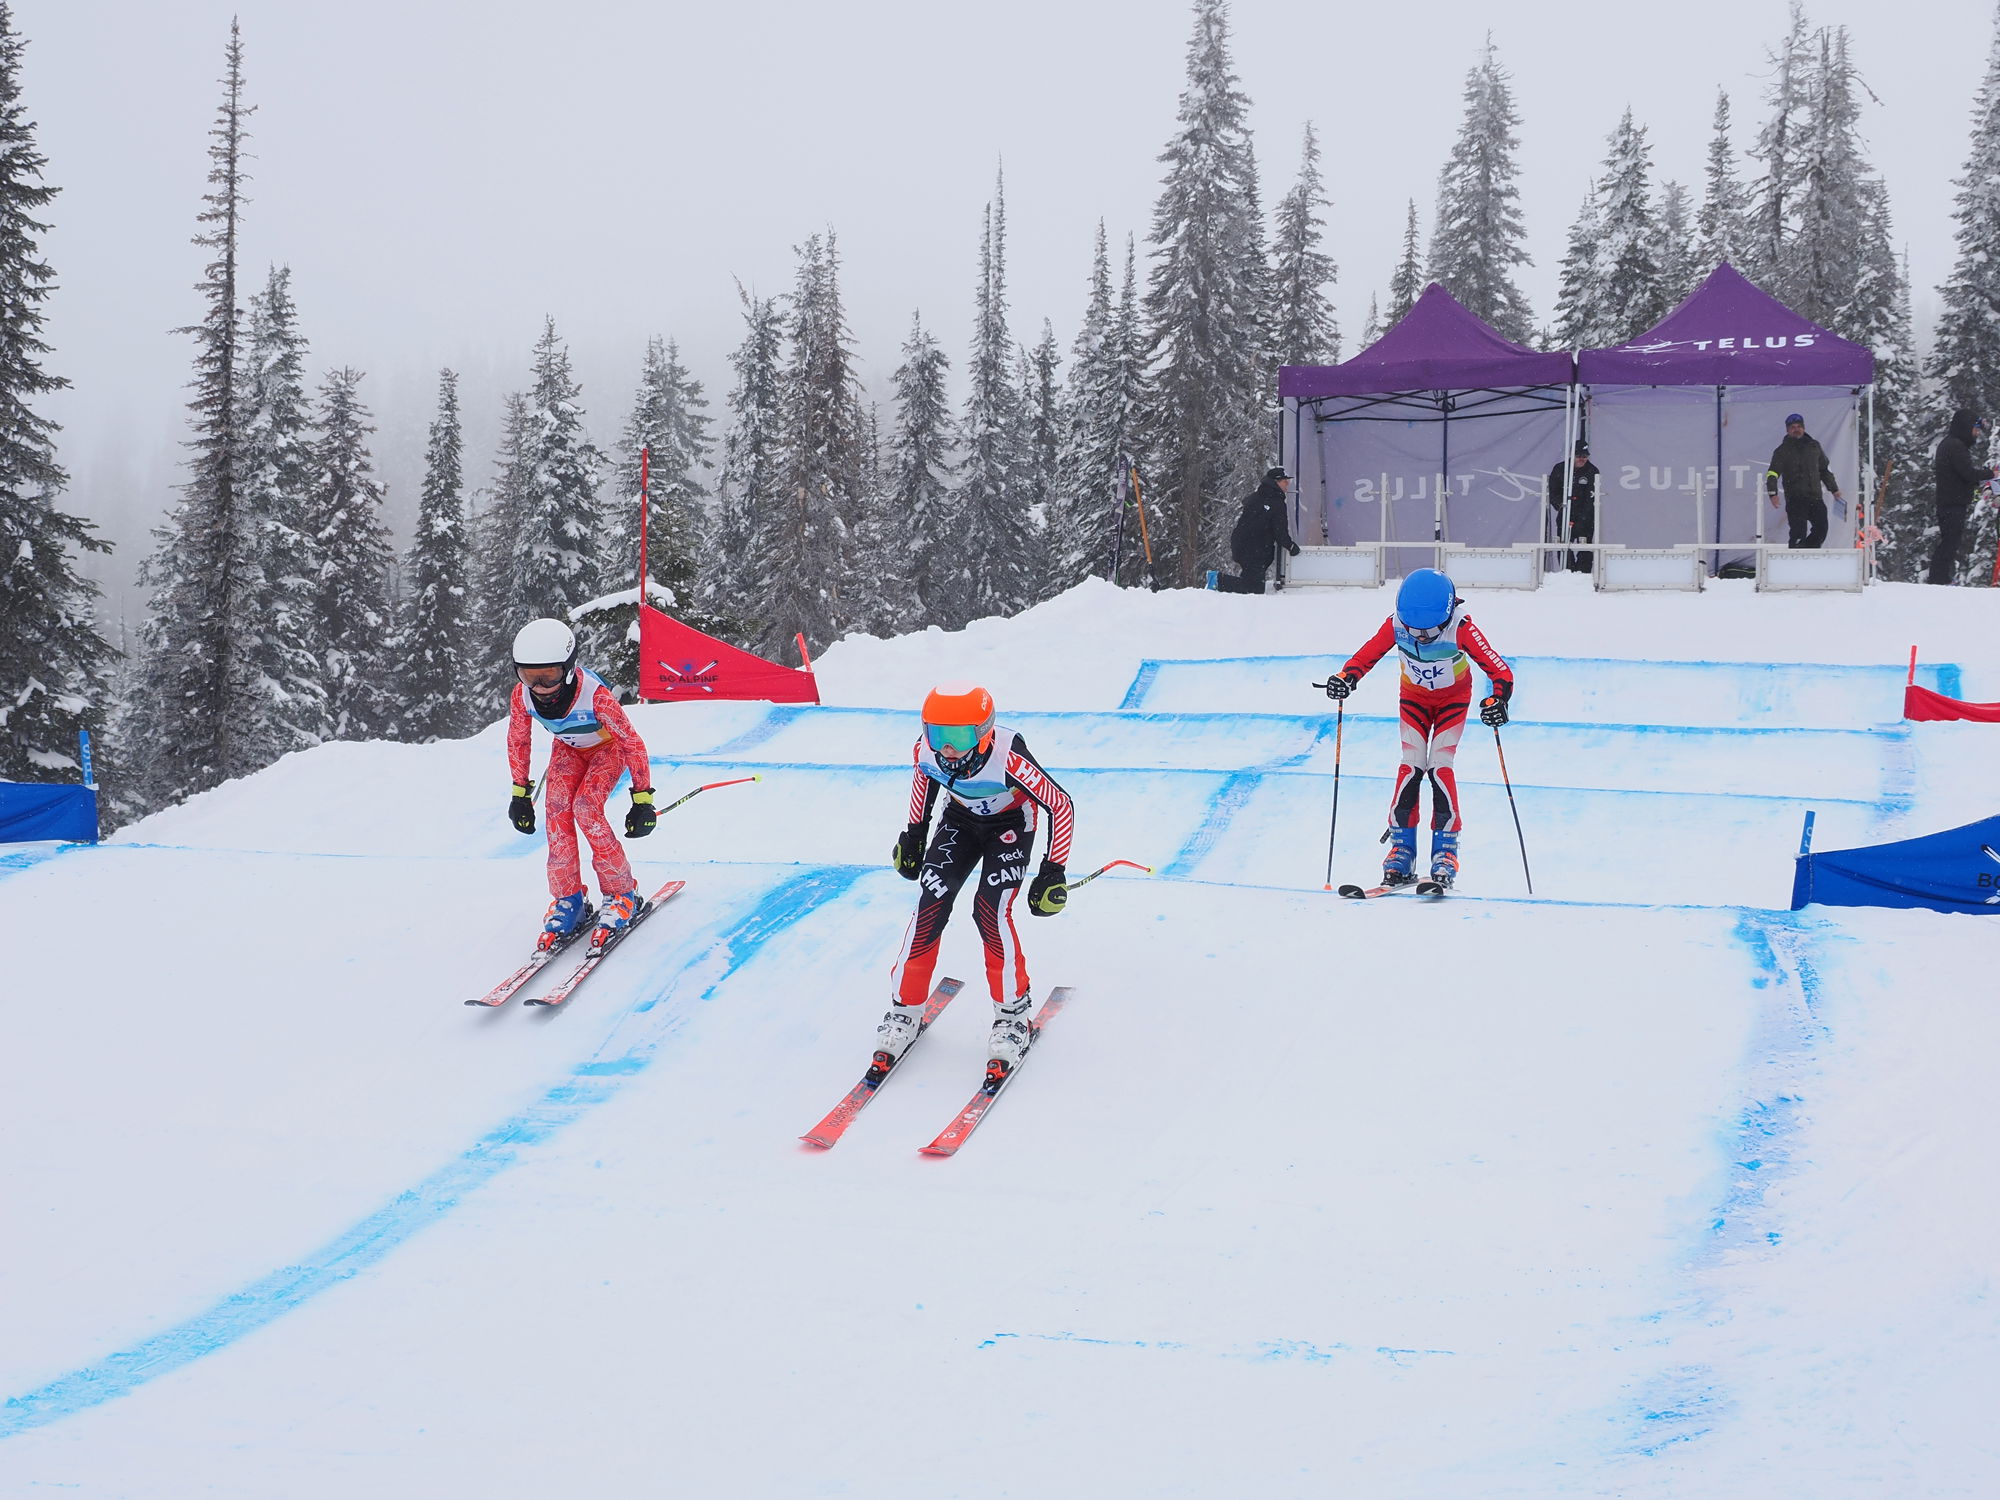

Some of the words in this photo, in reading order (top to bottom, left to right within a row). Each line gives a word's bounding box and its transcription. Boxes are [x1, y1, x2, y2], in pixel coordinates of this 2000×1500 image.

[1693, 334, 1815, 351] TELUS
[660, 675, 676, 683] BC
[1015, 760, 1042, 790] HH
[997, 848, 1025, 863] Teck
[921, 868, 949, 899] HH
